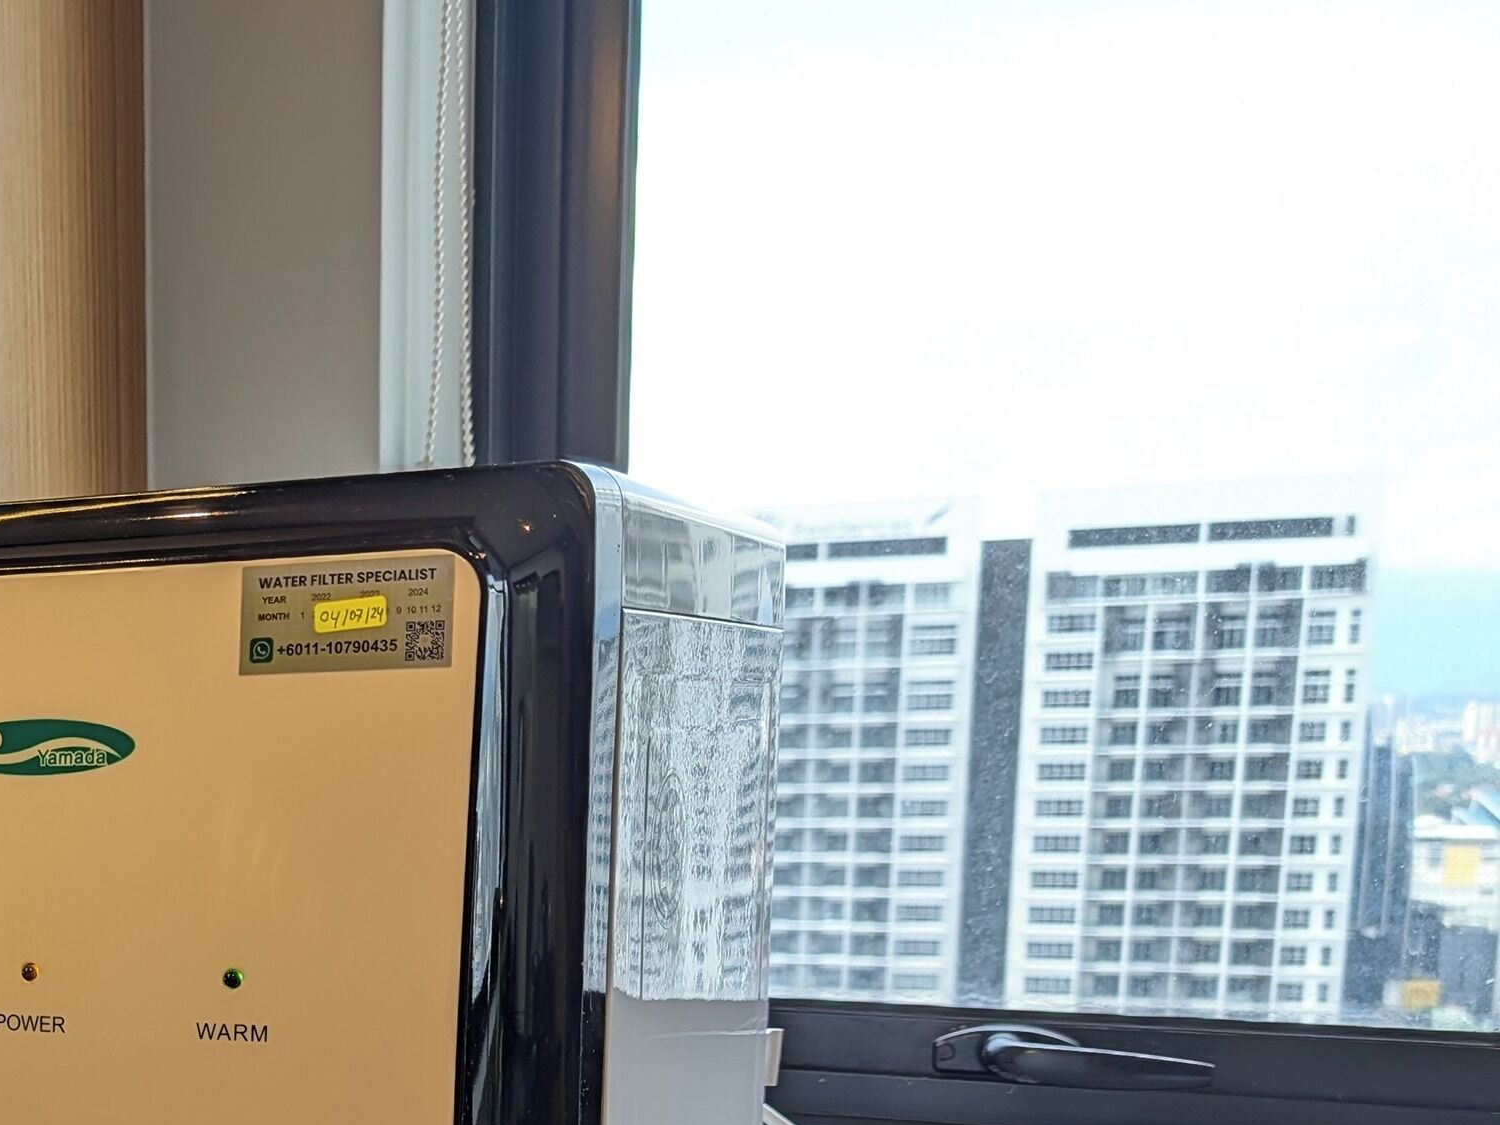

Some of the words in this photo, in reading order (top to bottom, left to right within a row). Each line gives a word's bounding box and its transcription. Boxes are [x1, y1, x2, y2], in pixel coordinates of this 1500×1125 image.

[259, 576, 307, 590] WATER
[310, 572, 354, 586] FILTER
[356, 567, 438, 584] SPECIALIST
[262, 595, 287, 605] YEAR
[408, 587, 429, 597] 2024
[258, 612, 290, 622] MONTH
[301, 612, 305, 620] 1
[407, 606, 417, 615] 10
[419, 605, 429, 614] 11
[431, 604, 442, 613] 12
[319, 607, 384, 628] 04/07/24
[277, 638, 398, 657] +6011-10790435
[37, 747, 108, 767] Yamada
[196, 1022, 269, 1043] WARM
